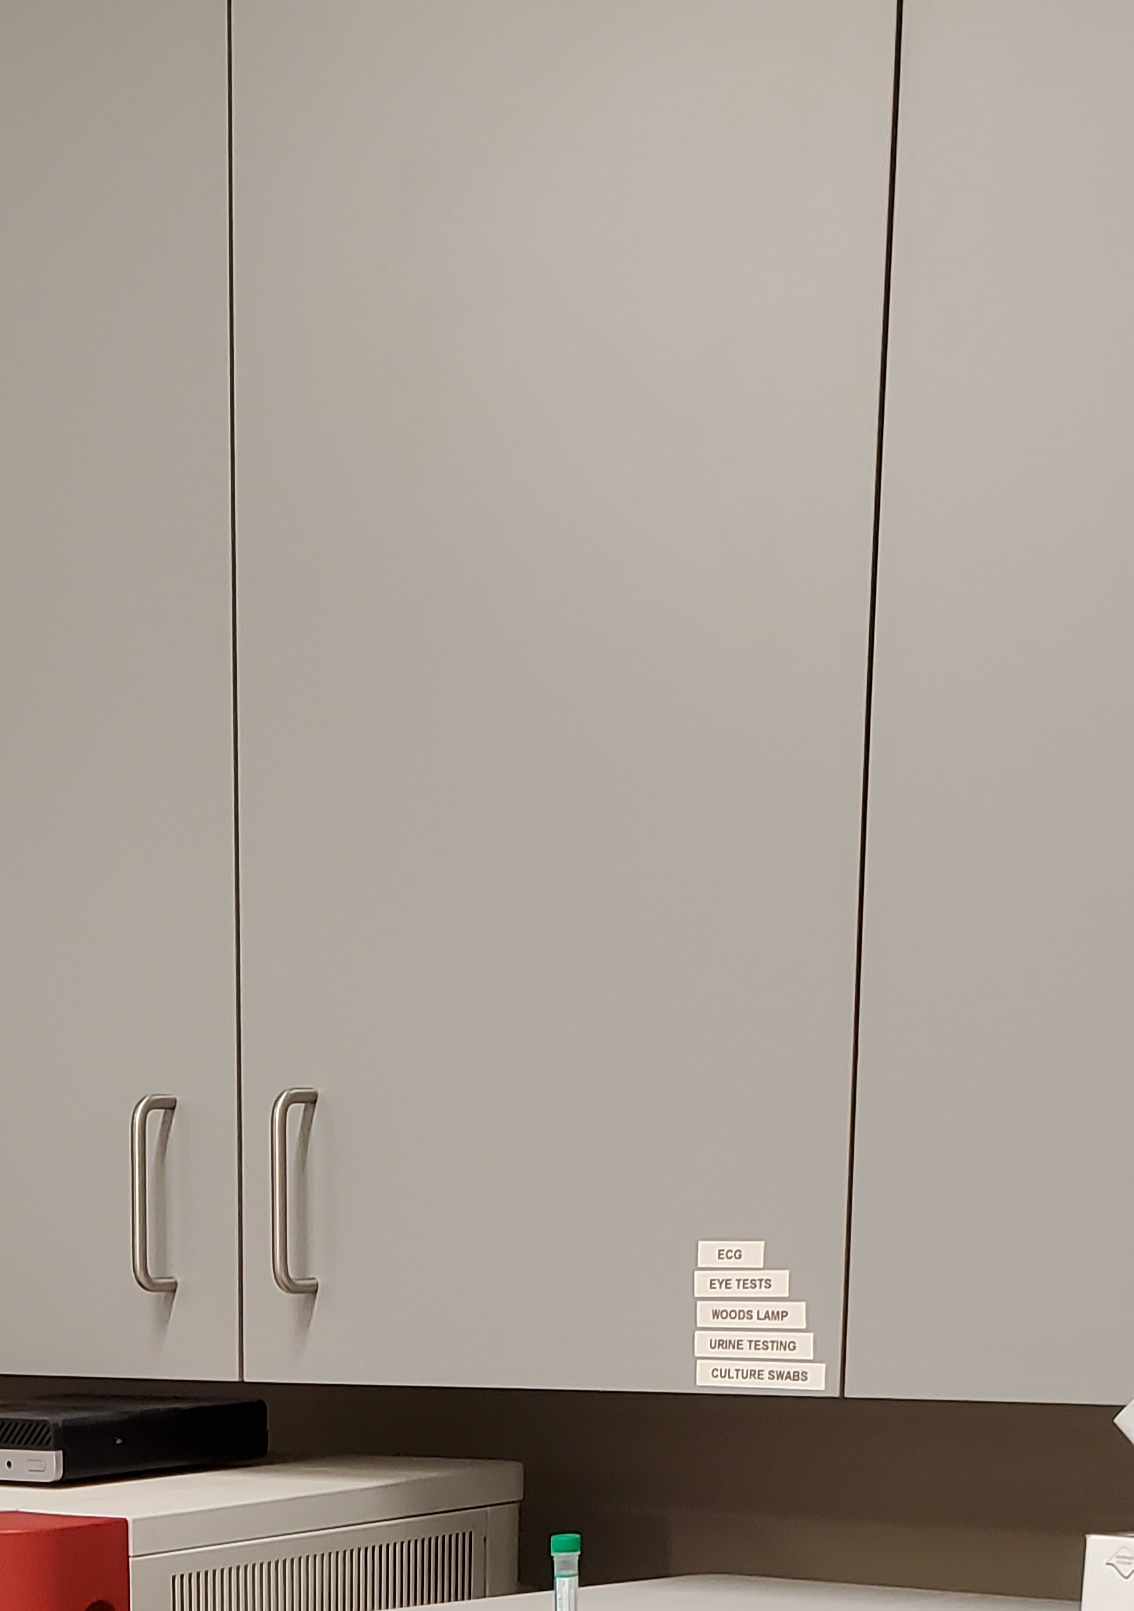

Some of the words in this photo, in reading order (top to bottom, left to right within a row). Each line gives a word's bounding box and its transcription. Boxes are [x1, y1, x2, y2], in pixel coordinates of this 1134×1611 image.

[717, 1249, 742, 1260] ECG
[709, 1278, 732, 1290] EYE
[736, 1278, 772, 1290] TESTS
[711, 1308, 753, 1320] WOODS
[756, 1310, 788, 1322] LAMP
[709, 1338, 744, 1350] URINE
[747, 1340, 796, 1352] TESTING
[711, 1368, 764, 1380] CULTURE
[768, 1370, 808, 1382] SWABS
